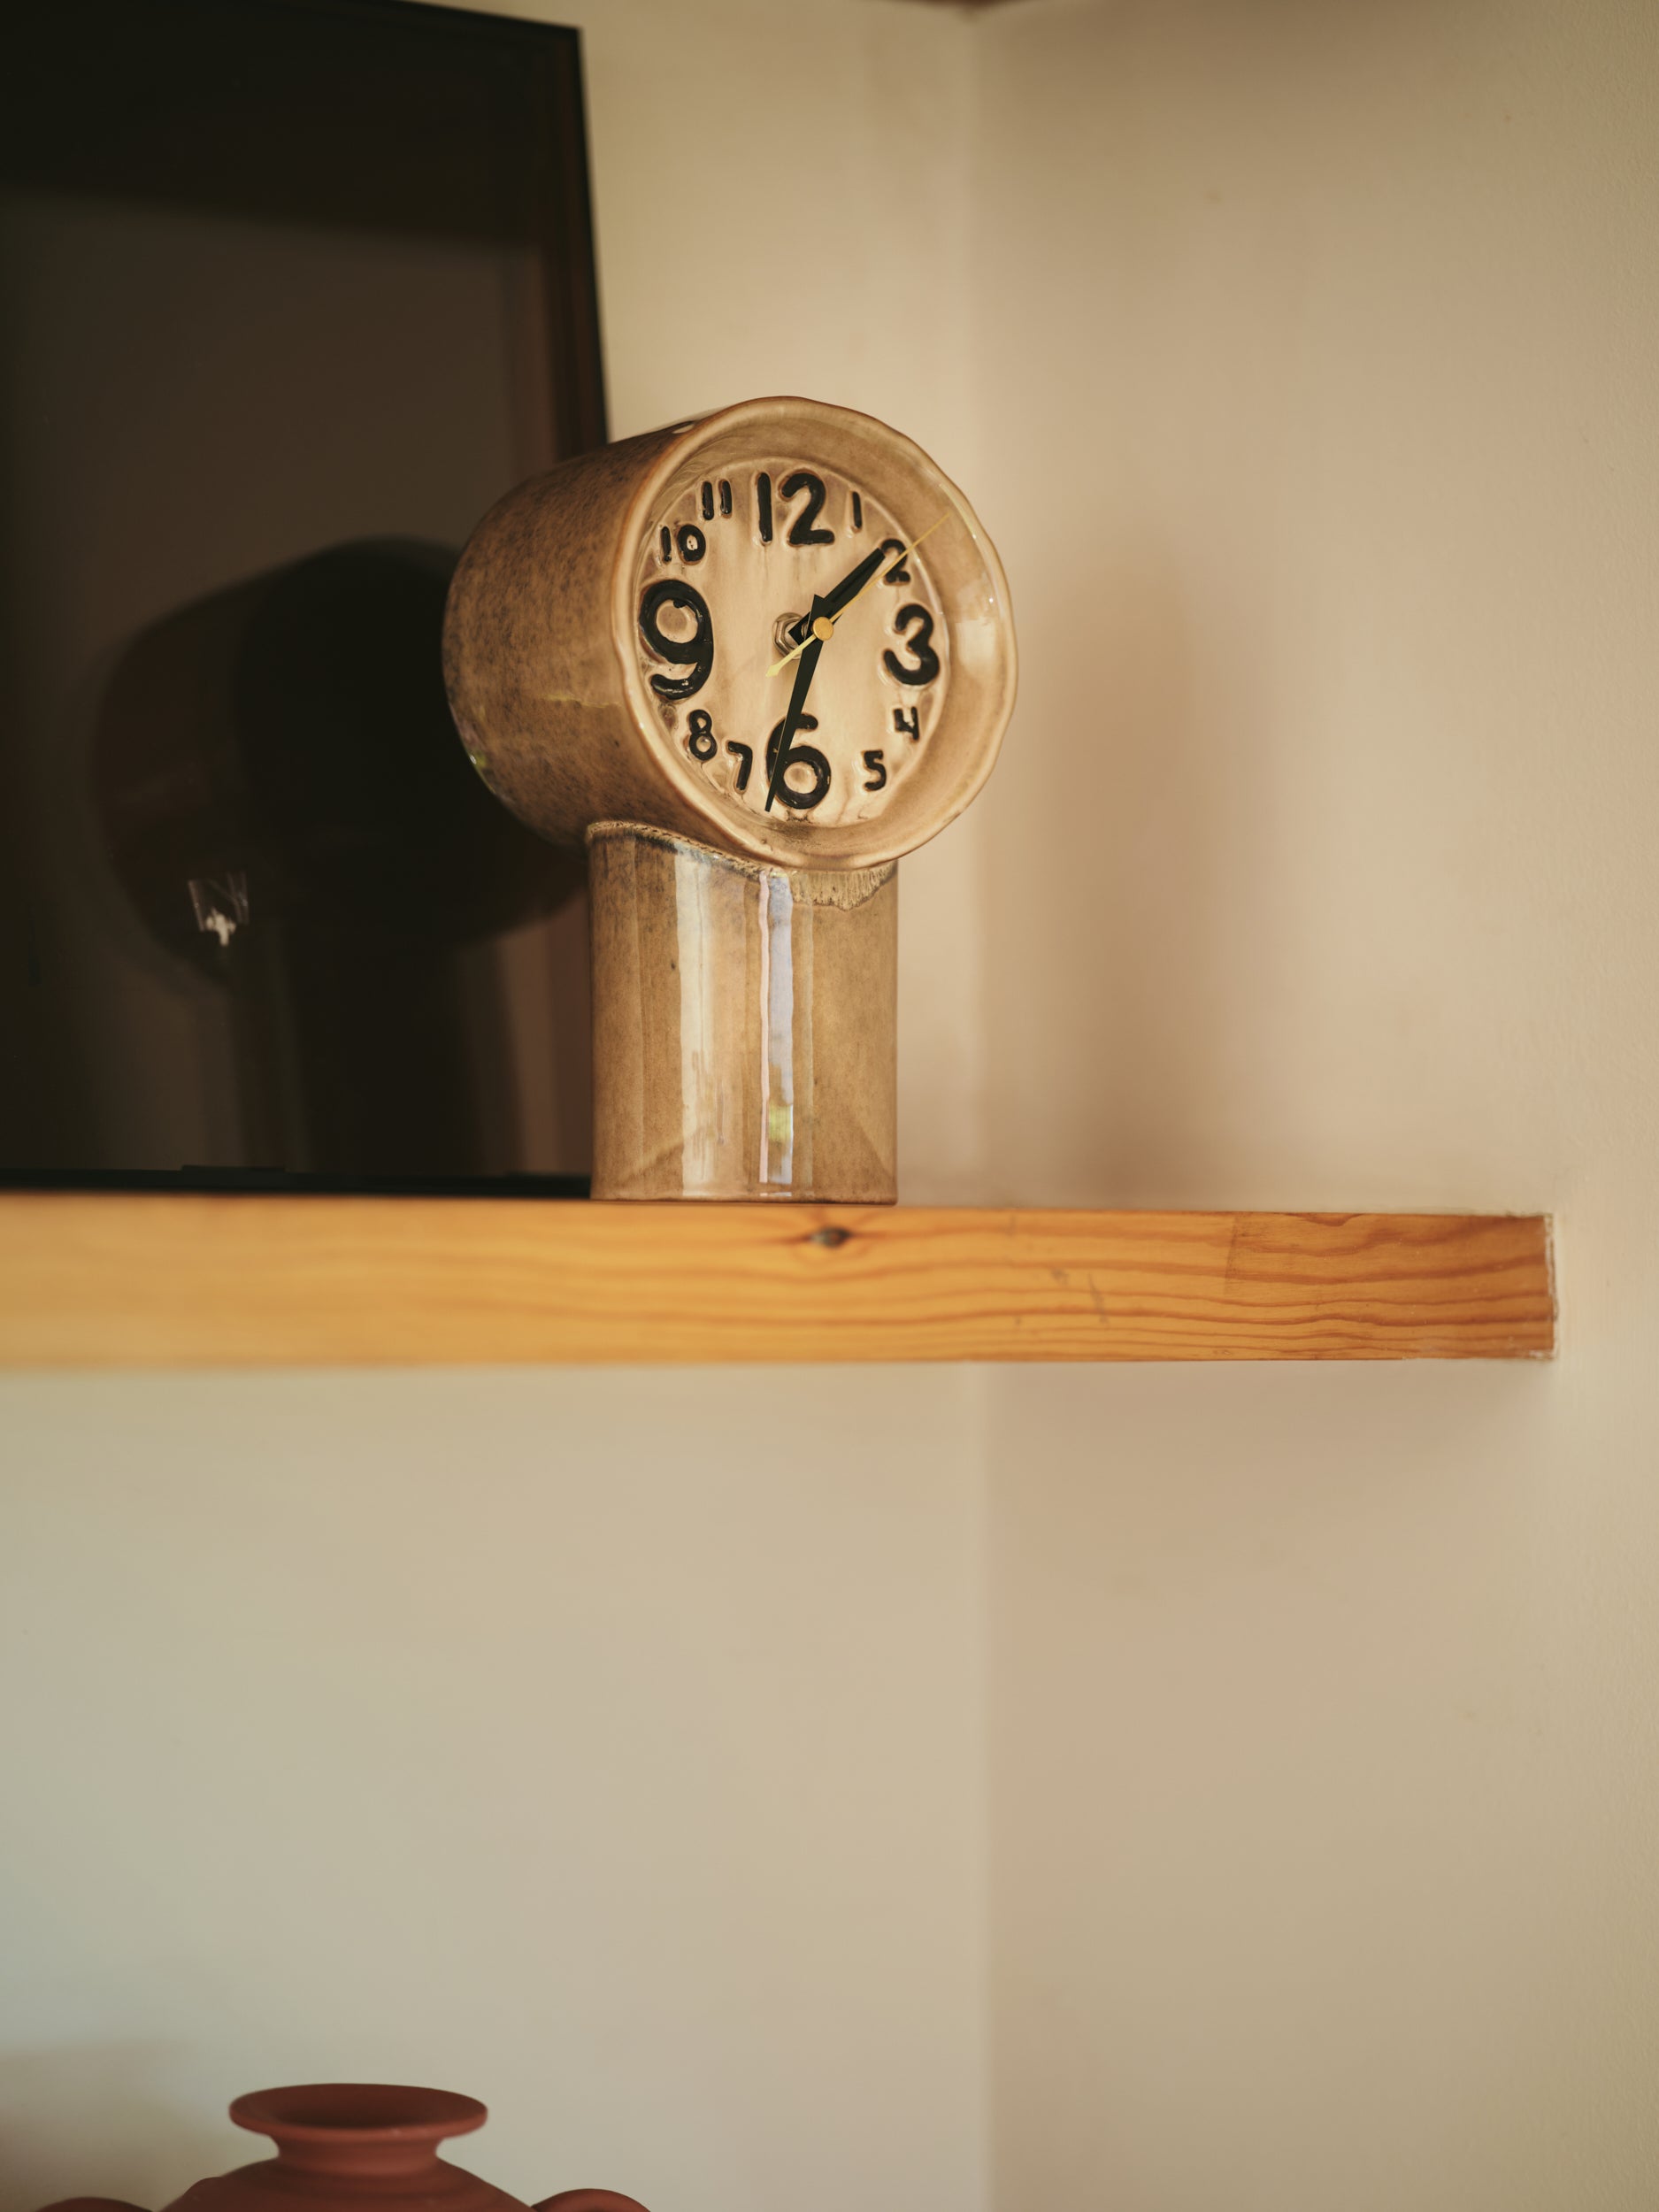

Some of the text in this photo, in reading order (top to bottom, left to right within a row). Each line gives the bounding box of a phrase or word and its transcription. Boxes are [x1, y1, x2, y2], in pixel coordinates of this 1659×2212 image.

[701, 480, 733, 520] 11
[757, 472, 835, 546] 12
[851, 490, 863, 529] 1
[659, 524, 707, 563] 10
[880, 538, 911, 584] 2
[639, 580, 714, 700] 9
[884, 603, 940, 686] 3
[688, 709, 718, 762] 8
[893, 706, 919, 741] 4
[727, 741, 753, 791] 7
[766, 713, 831, 810] 6
[863, 749, 887, 791] 5
